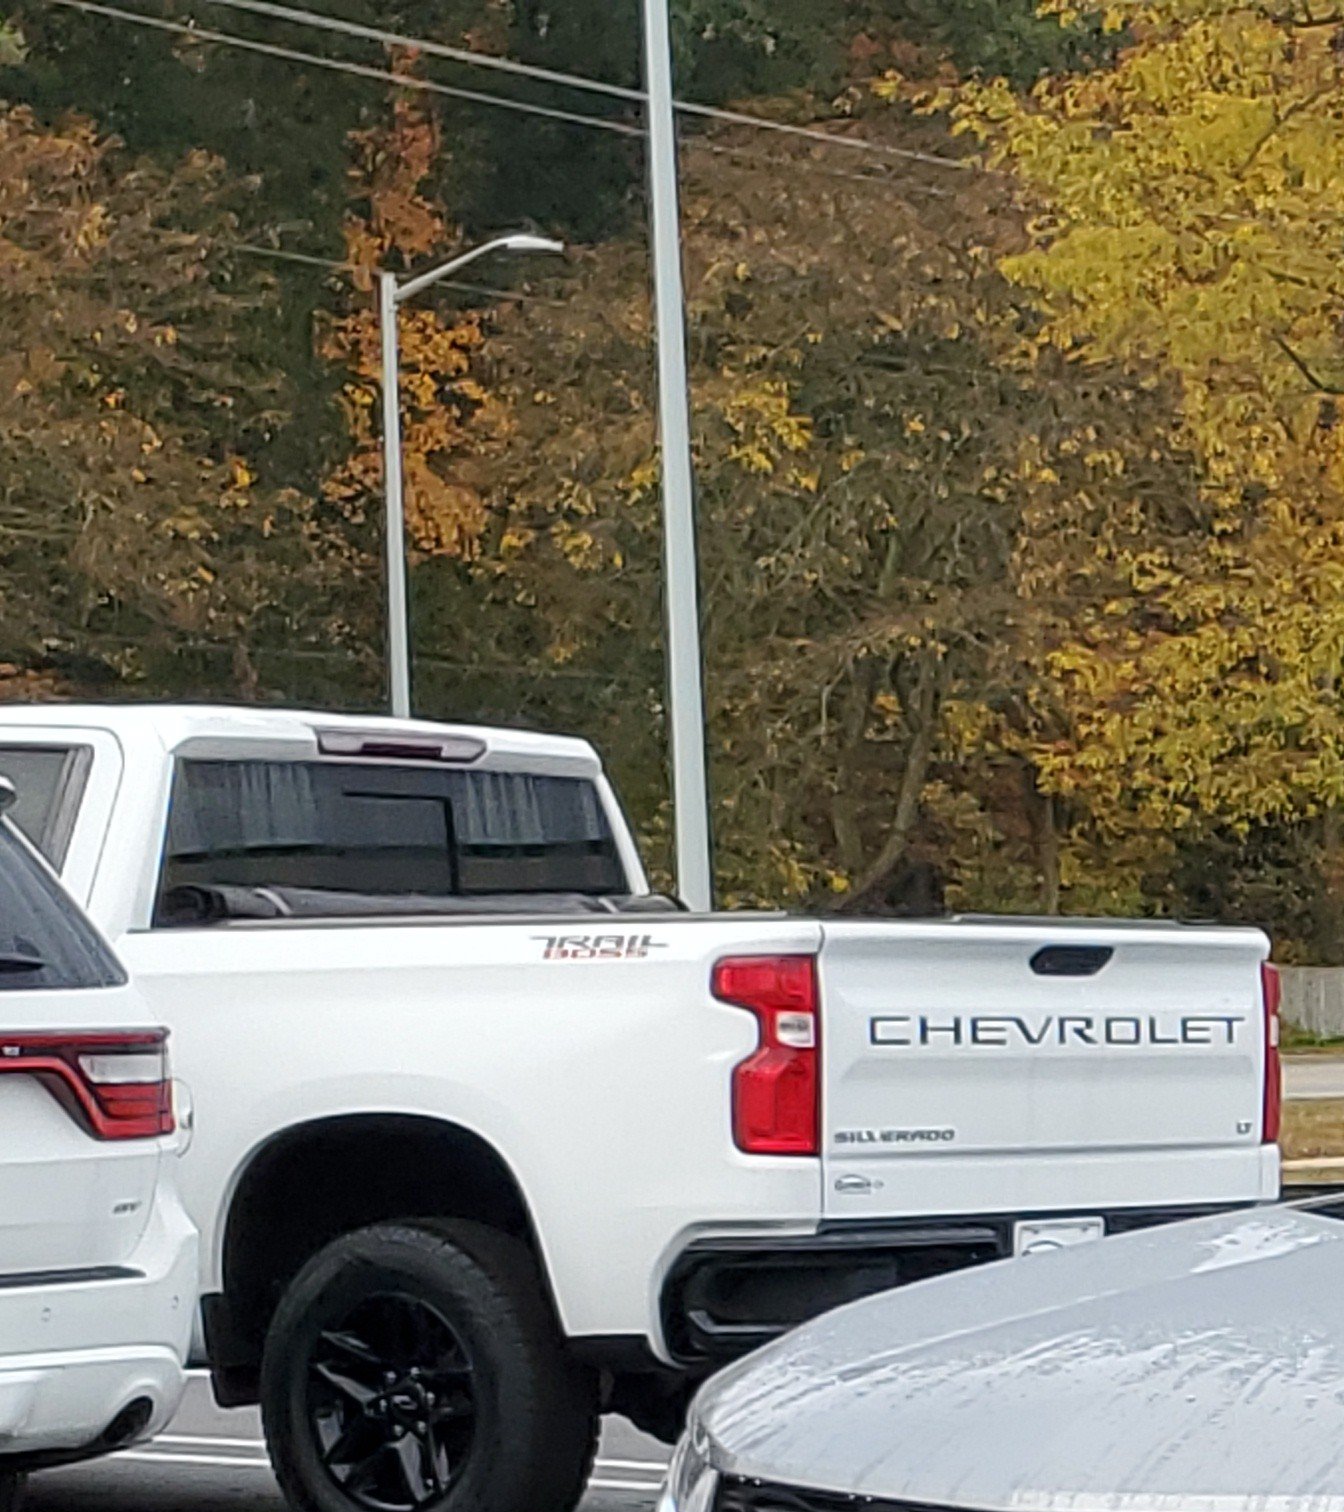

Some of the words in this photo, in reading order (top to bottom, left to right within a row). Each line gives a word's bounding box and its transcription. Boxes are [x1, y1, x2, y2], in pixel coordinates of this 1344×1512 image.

[529, 935, 669, 950] TRAIL
[869, 1015, 1246, 1046] CHEVROLET
[833, 1129, 955, 1144] SILVERADO
